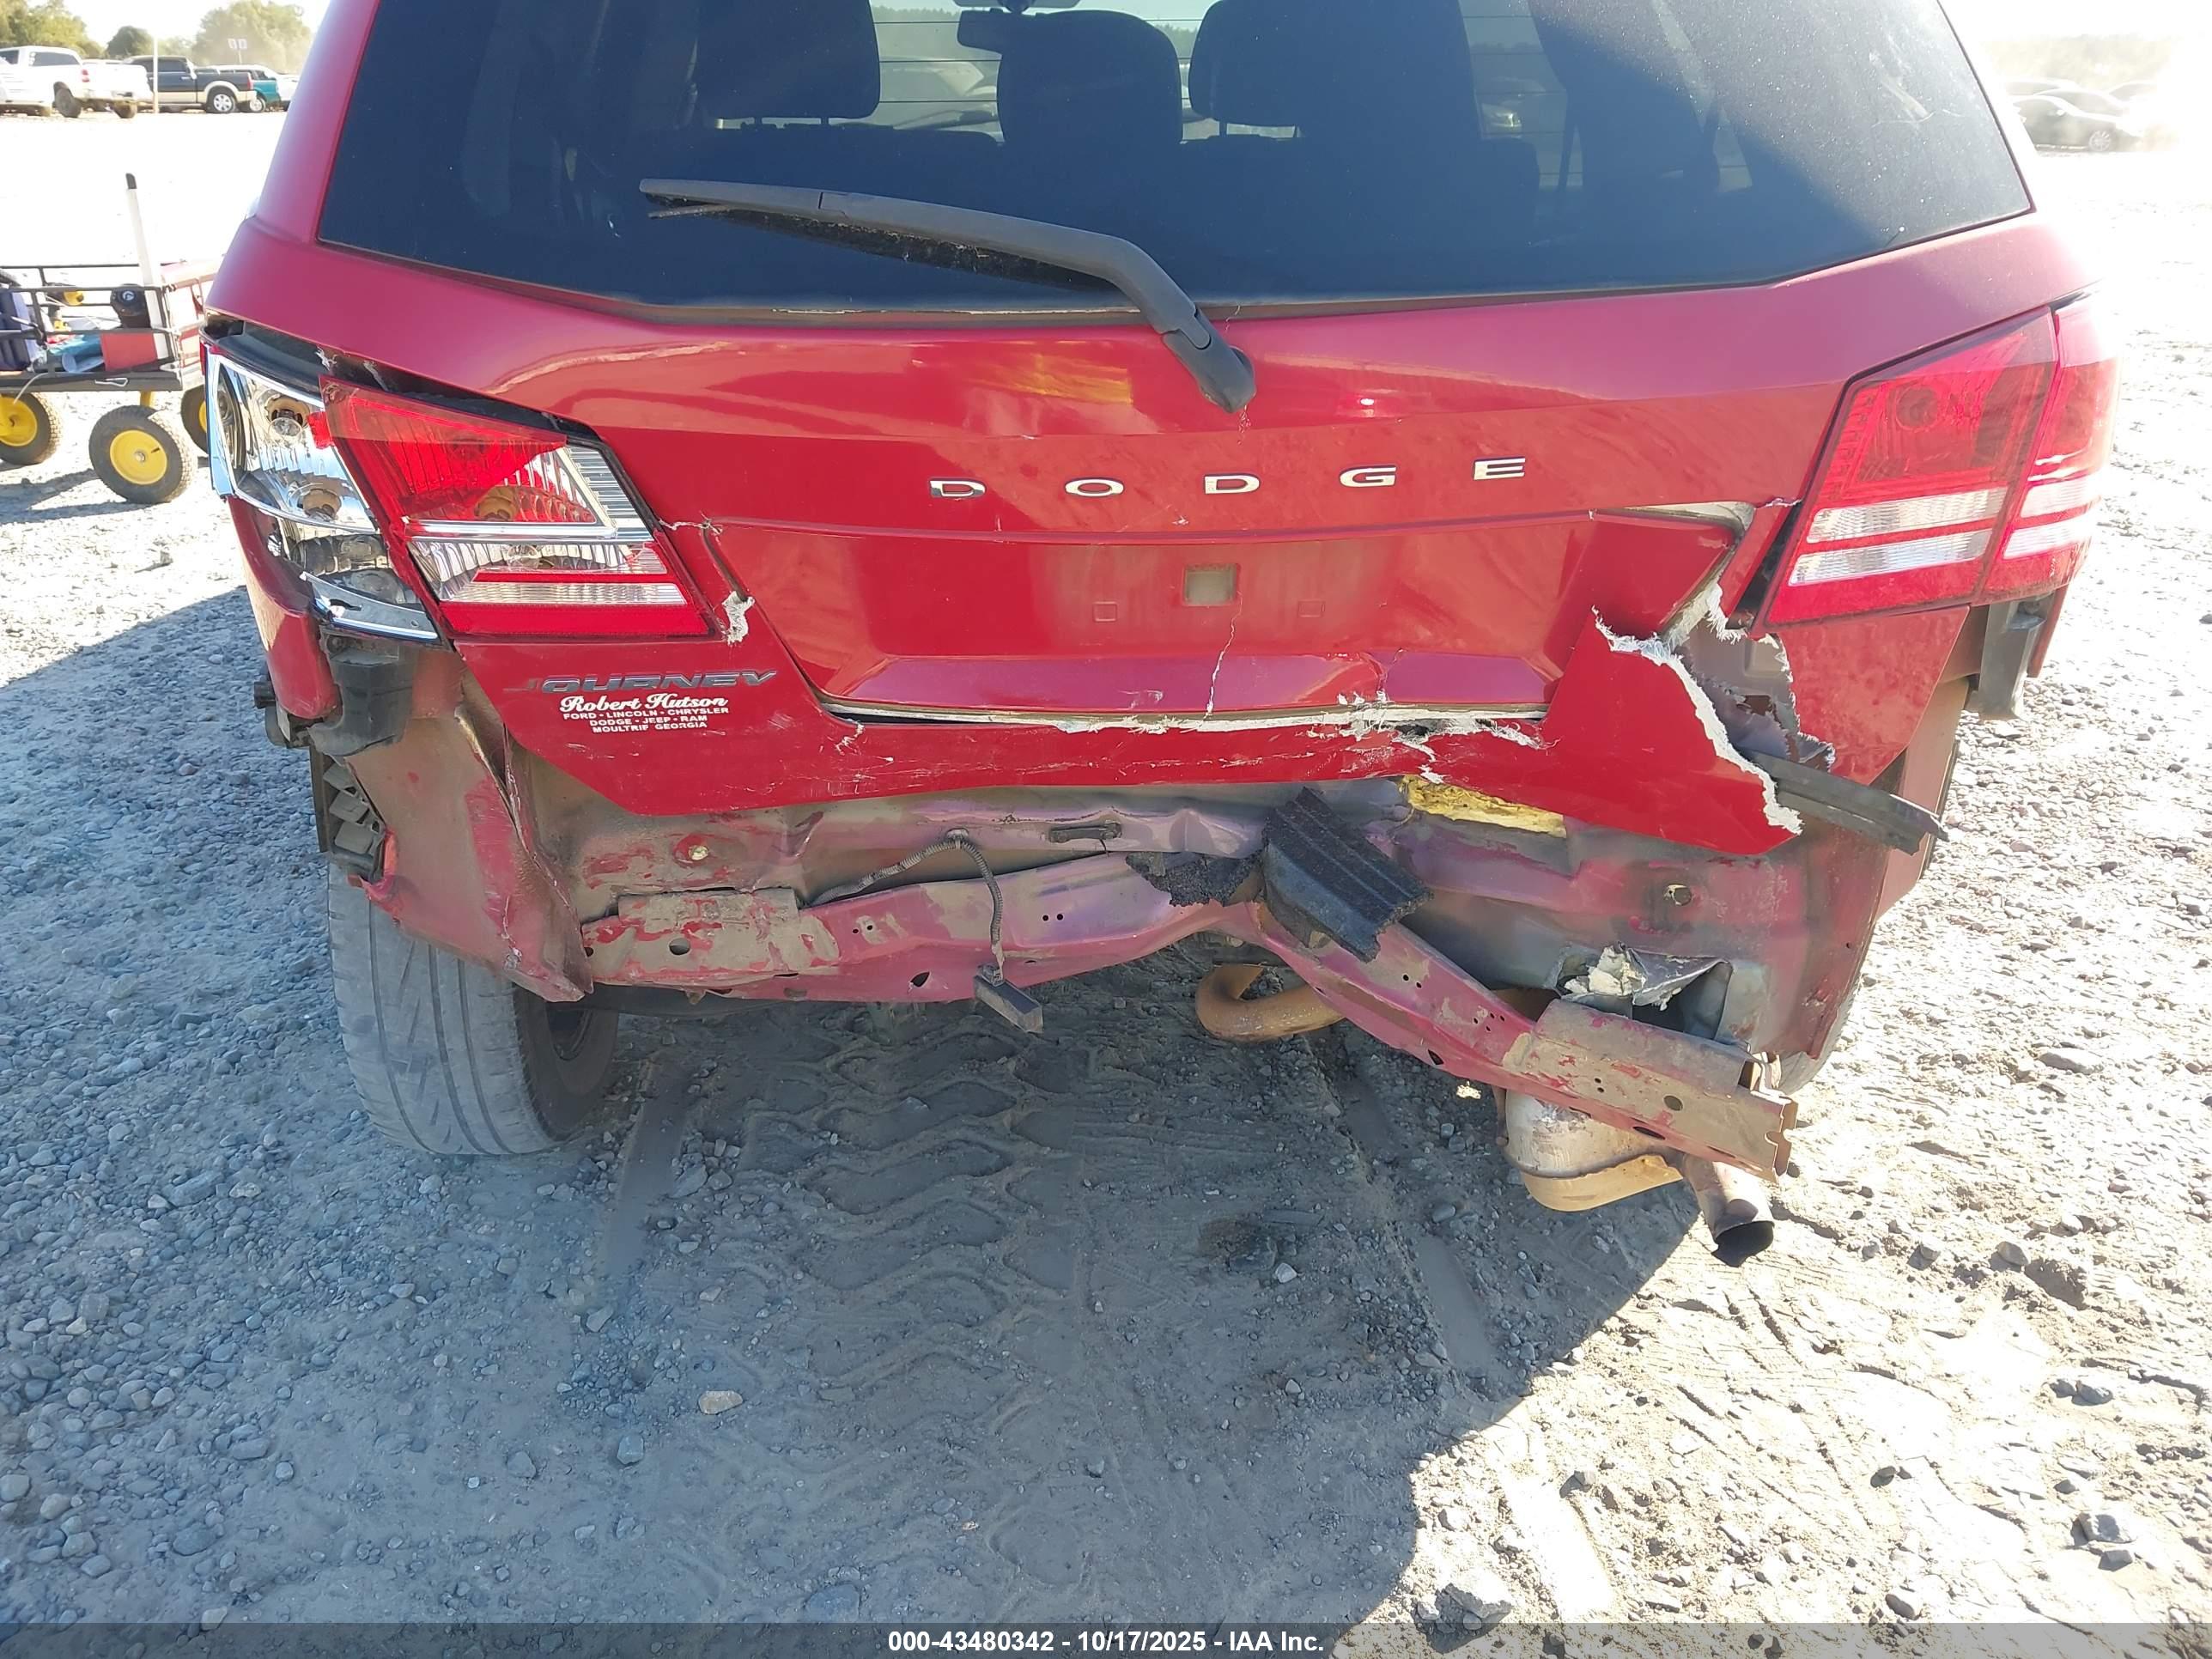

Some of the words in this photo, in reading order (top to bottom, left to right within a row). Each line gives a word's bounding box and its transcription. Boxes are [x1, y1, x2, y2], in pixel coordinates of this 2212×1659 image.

[930, 457, 1526, 499] DODGE
[559, 695, 641, 712] Robert
[644, 692, 729, 709] Hutson
[606, 709, 658, 719] LINCOLN
[667, 707, 729, 716] CHRYSLER
[589, 718, 632, 726] DODGE
[654, 721, 708, 730] GEORGIA
